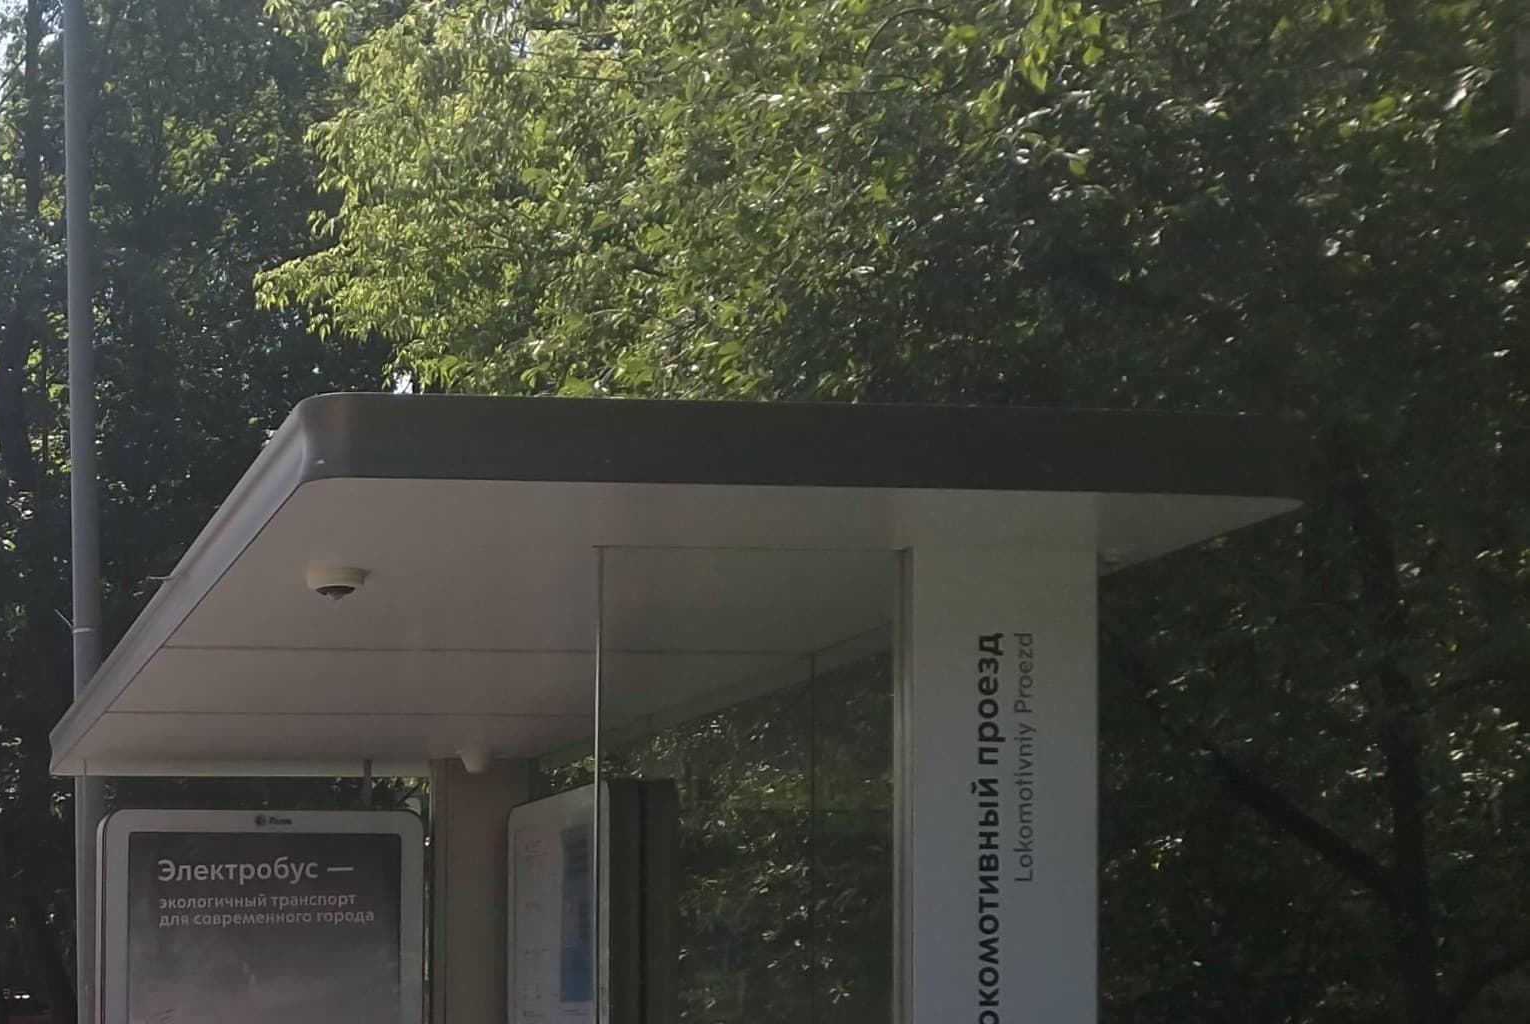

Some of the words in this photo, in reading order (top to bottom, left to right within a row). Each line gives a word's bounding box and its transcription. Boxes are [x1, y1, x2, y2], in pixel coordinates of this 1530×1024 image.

[977, 633, 1006, 764] проезд
[1013, 632, 1033, 713] Proezd
[1013, 723, 1037, 882] Lokomotivniy
[157, 857, 319, 885] Электробус
[159, 894, 267, 909] экологичный
[270, 893, 357, 910] транспорт
[159, 912, 190, 928] для
[193, 911, 312, 928] современного
[316, 910, 375, 926] города
